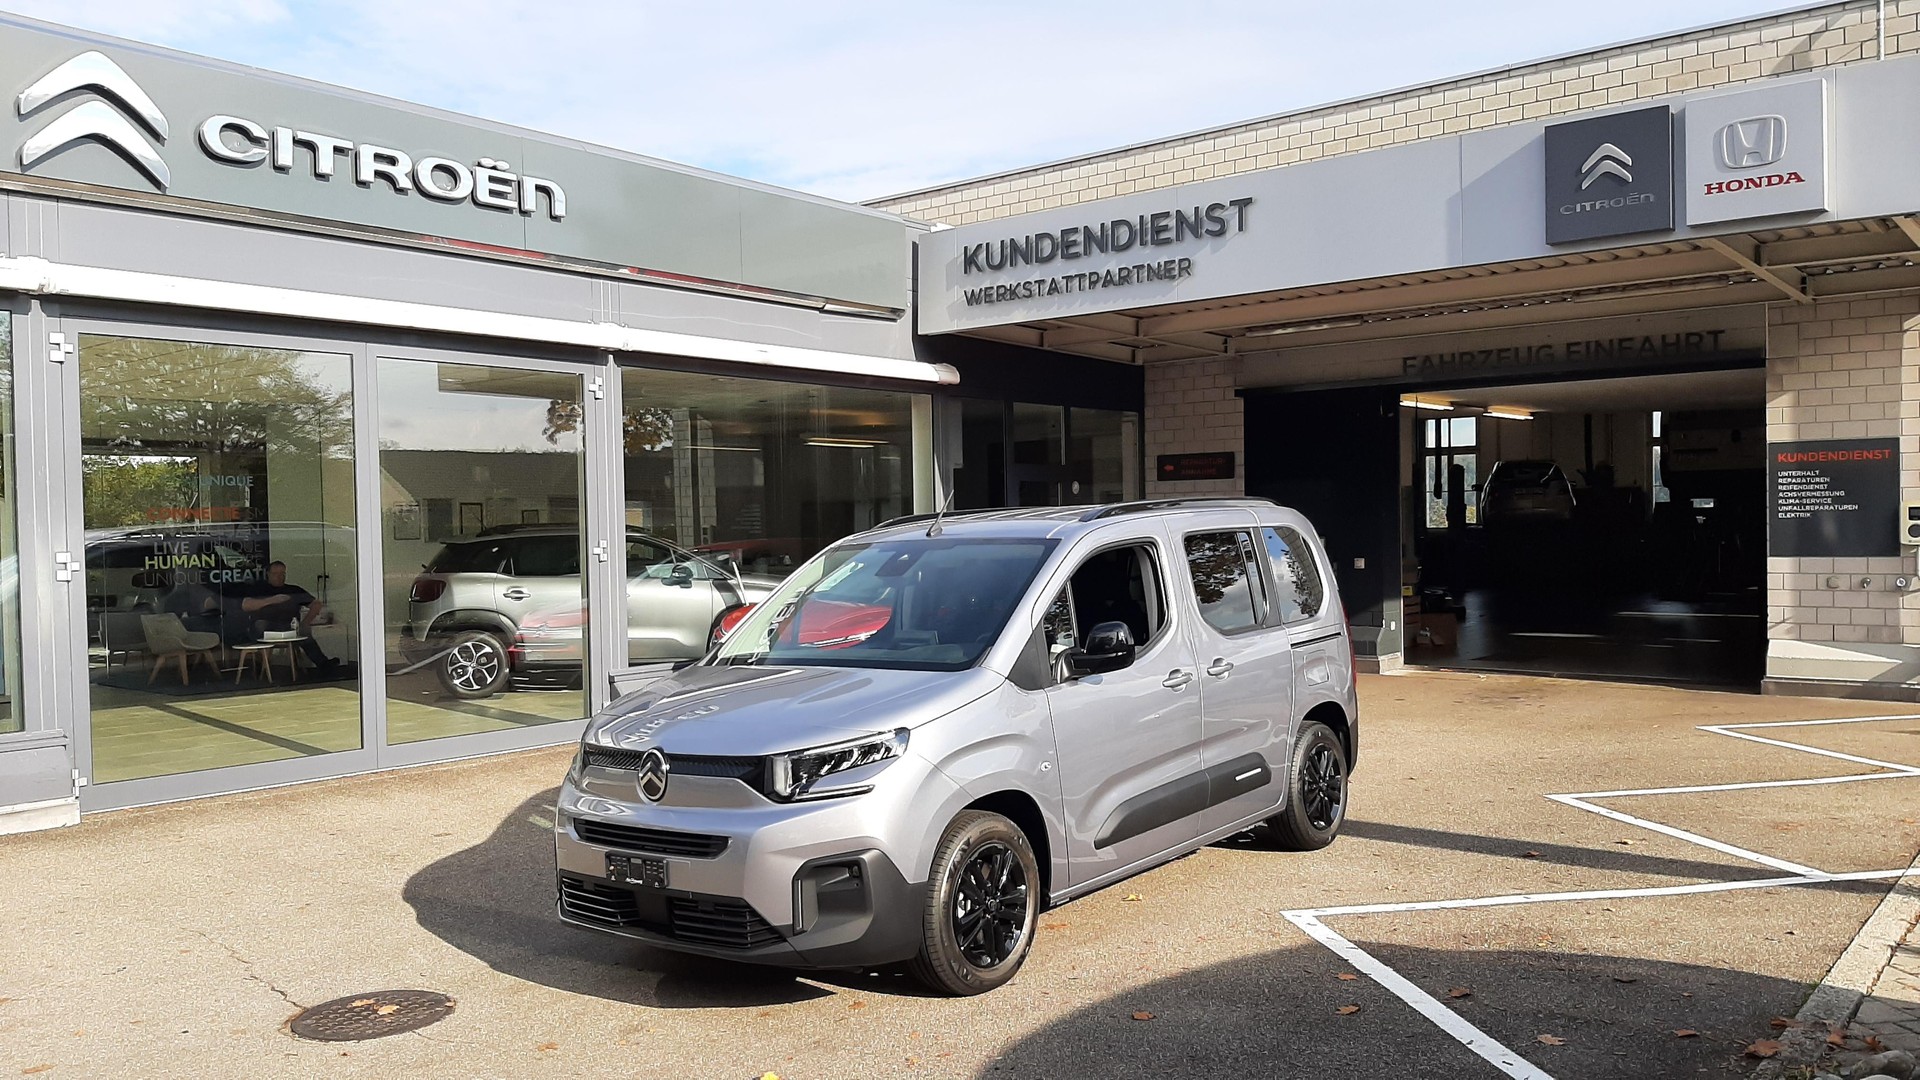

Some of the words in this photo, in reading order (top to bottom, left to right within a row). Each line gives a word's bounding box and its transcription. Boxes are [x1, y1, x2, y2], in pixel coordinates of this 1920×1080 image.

[1704, 171, 1806, 195] HONDA
[962, 196, 1254, 275] KUNDENDIENST
[963, 257, 1194, 307] WERKSTATTPARTNER
[1401, 343, 1555, 376] FAHRZEUG
[1565, 329, 1726, 363] EINFAHRT
[1777, 449, 1892, 463] KUNDENDIENST
[154, 541, 190, 555] LIVE
[145, 554, 216, 571] HUMAN
[144, 570, 207, 587] UNIQUE
